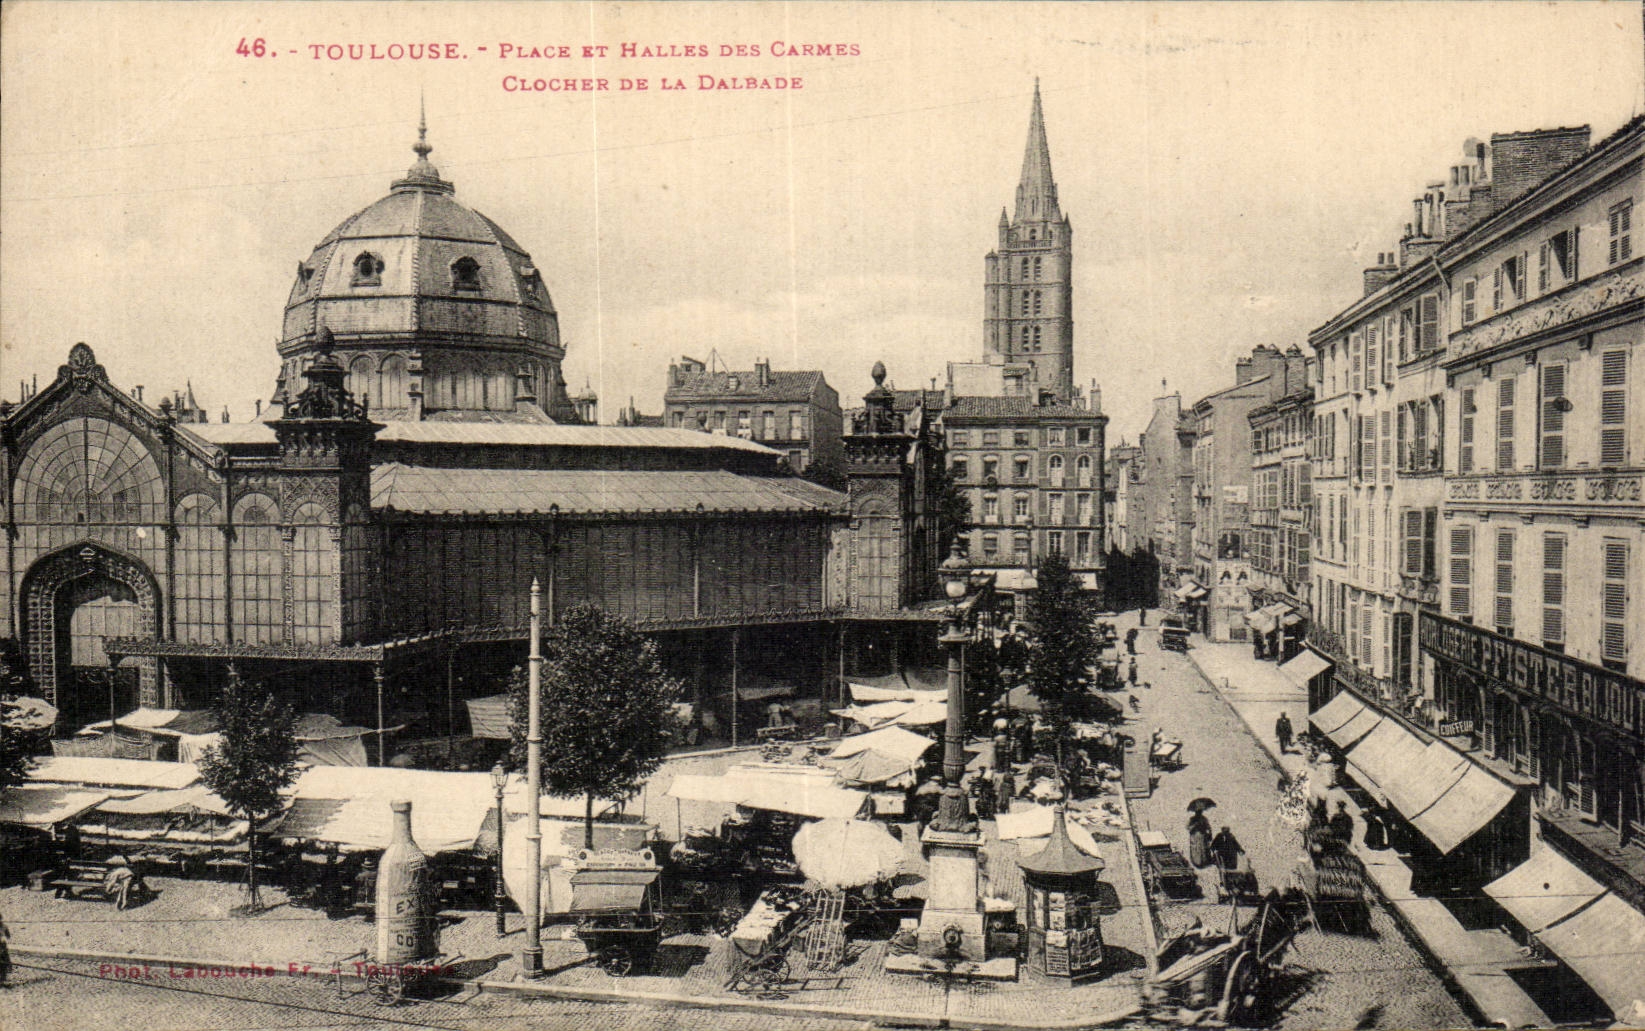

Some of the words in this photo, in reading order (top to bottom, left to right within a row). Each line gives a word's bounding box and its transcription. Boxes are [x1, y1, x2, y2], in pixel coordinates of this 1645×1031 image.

[1420, 614, 1478, 668] HORLOGERIE
[1482, 634, 1579, 713] PFISTER
[1440, 720, 1474, 735] COIFFEUR
